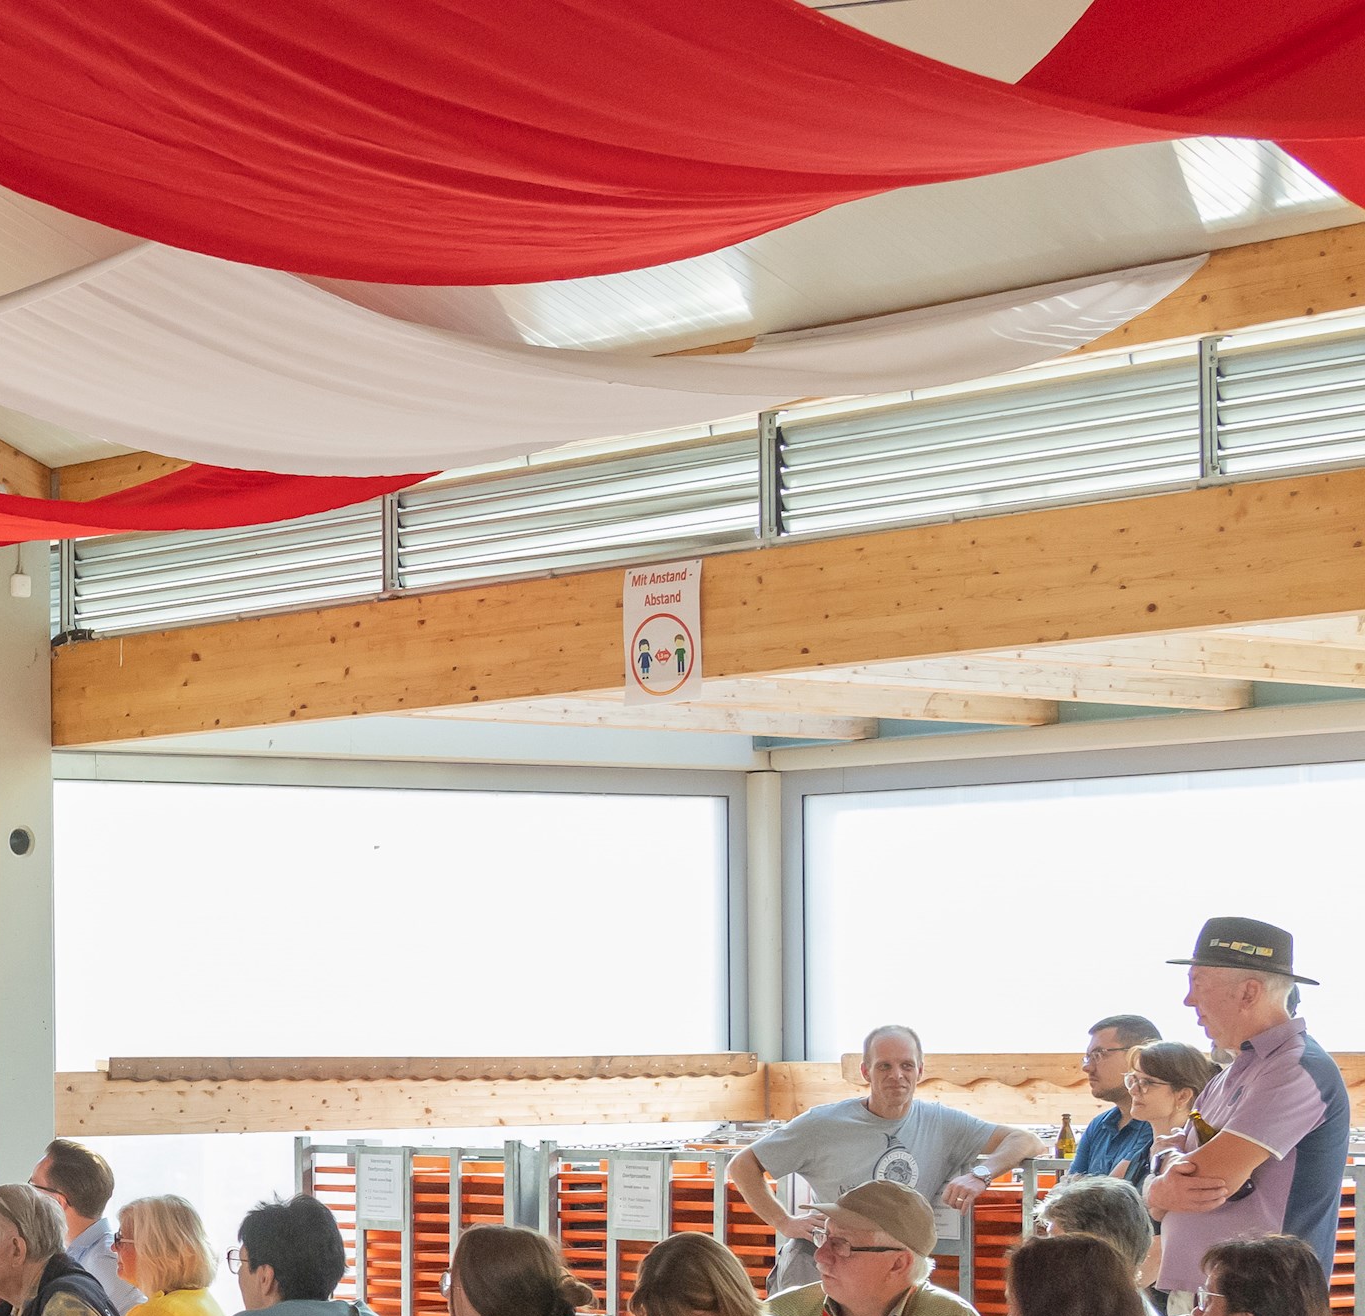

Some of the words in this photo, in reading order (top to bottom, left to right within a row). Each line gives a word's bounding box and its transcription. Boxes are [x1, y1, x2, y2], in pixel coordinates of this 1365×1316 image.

[631, 574, 647, 587] Mit
[649, 568, 687, 585] Anstand
[644, 590, 681, 607] Abstand
